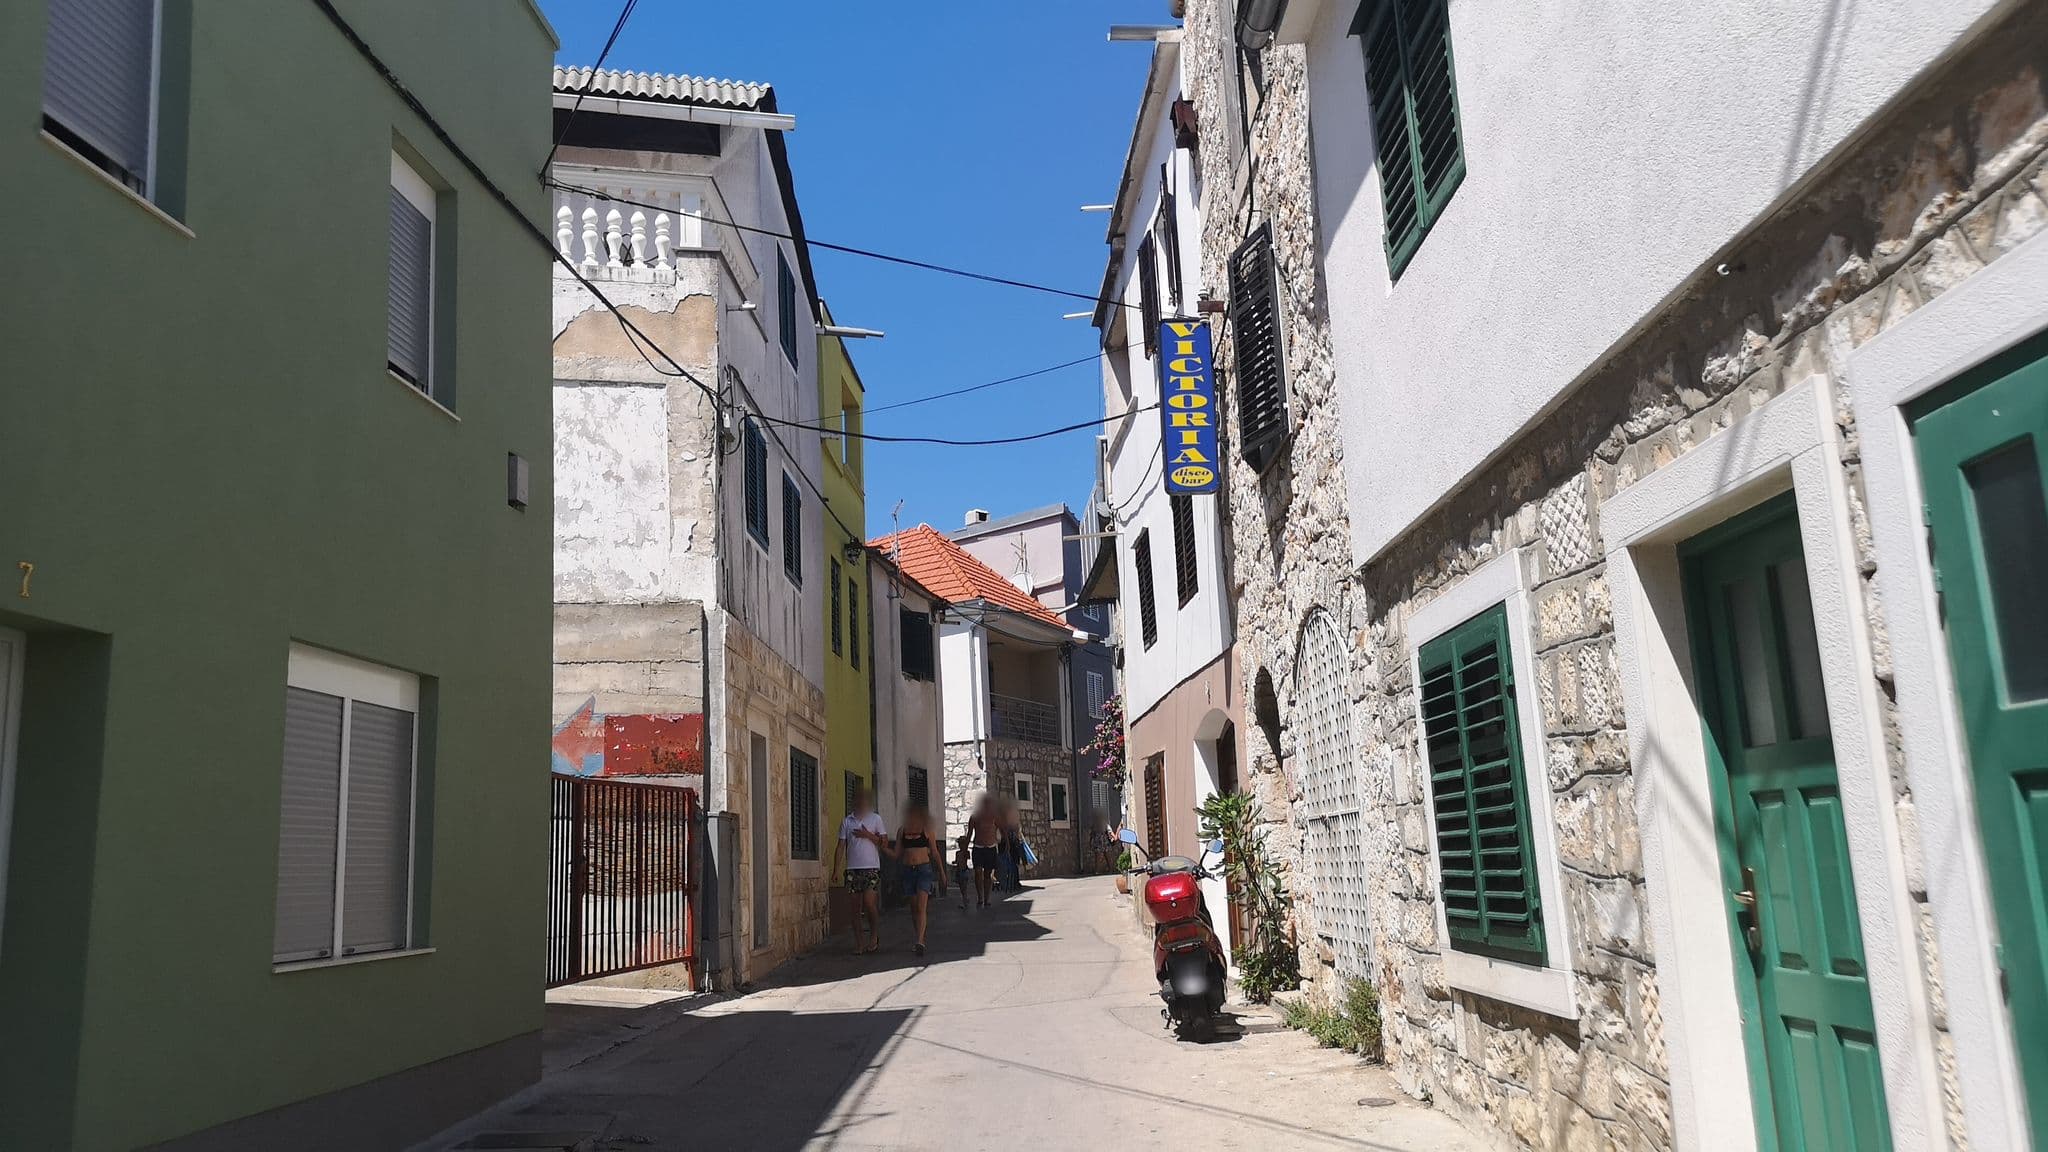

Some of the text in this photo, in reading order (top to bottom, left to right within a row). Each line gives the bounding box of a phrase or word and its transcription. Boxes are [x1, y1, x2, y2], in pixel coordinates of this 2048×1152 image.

[1165, 322, 1212, 464] VICTORIA
[1175, 468, 1210, 477] disco
[1181, 476, 1205, 484] bar
[16, 561, 33, 599] 7
